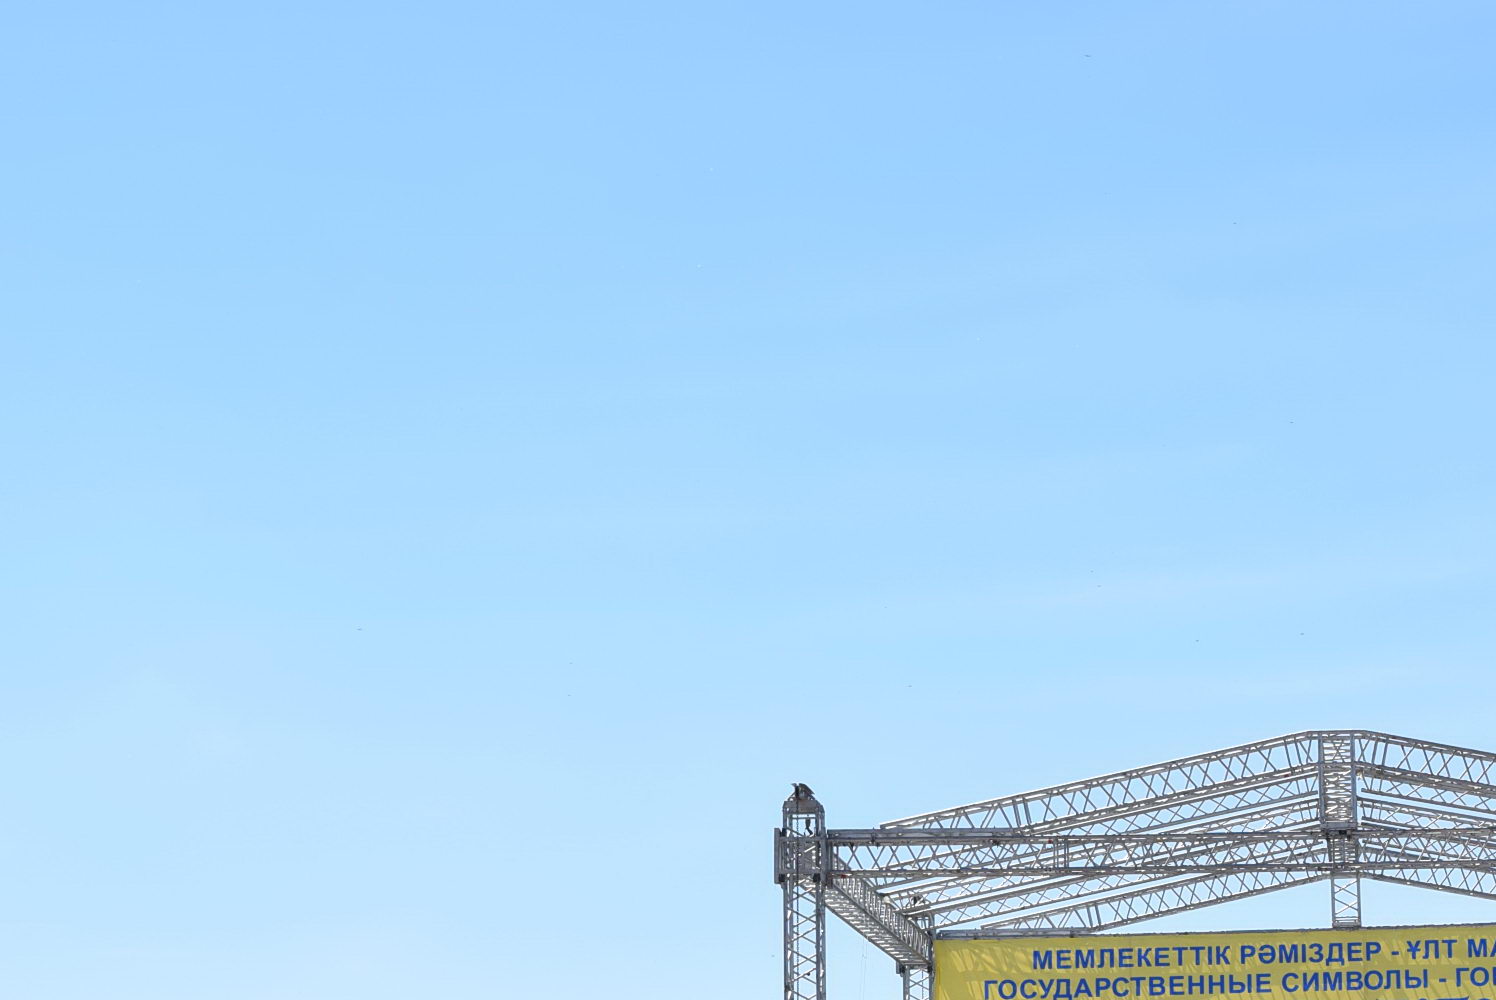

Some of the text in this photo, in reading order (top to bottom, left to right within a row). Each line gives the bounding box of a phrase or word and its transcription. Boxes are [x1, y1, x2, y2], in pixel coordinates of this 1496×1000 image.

[1032, 946, 1230, 969] МЕМЛЕКЕТТІК
[1240, 942, 1381, 966] РӘМІЗДЕР
[1407, 940, 1457, 959] ҰЛТ
[984, 974, 1271, 1000] ГОСУДАРСТВЕННЫЕ
[1281, 970, 1429, 993] СИМВОЛЫ
